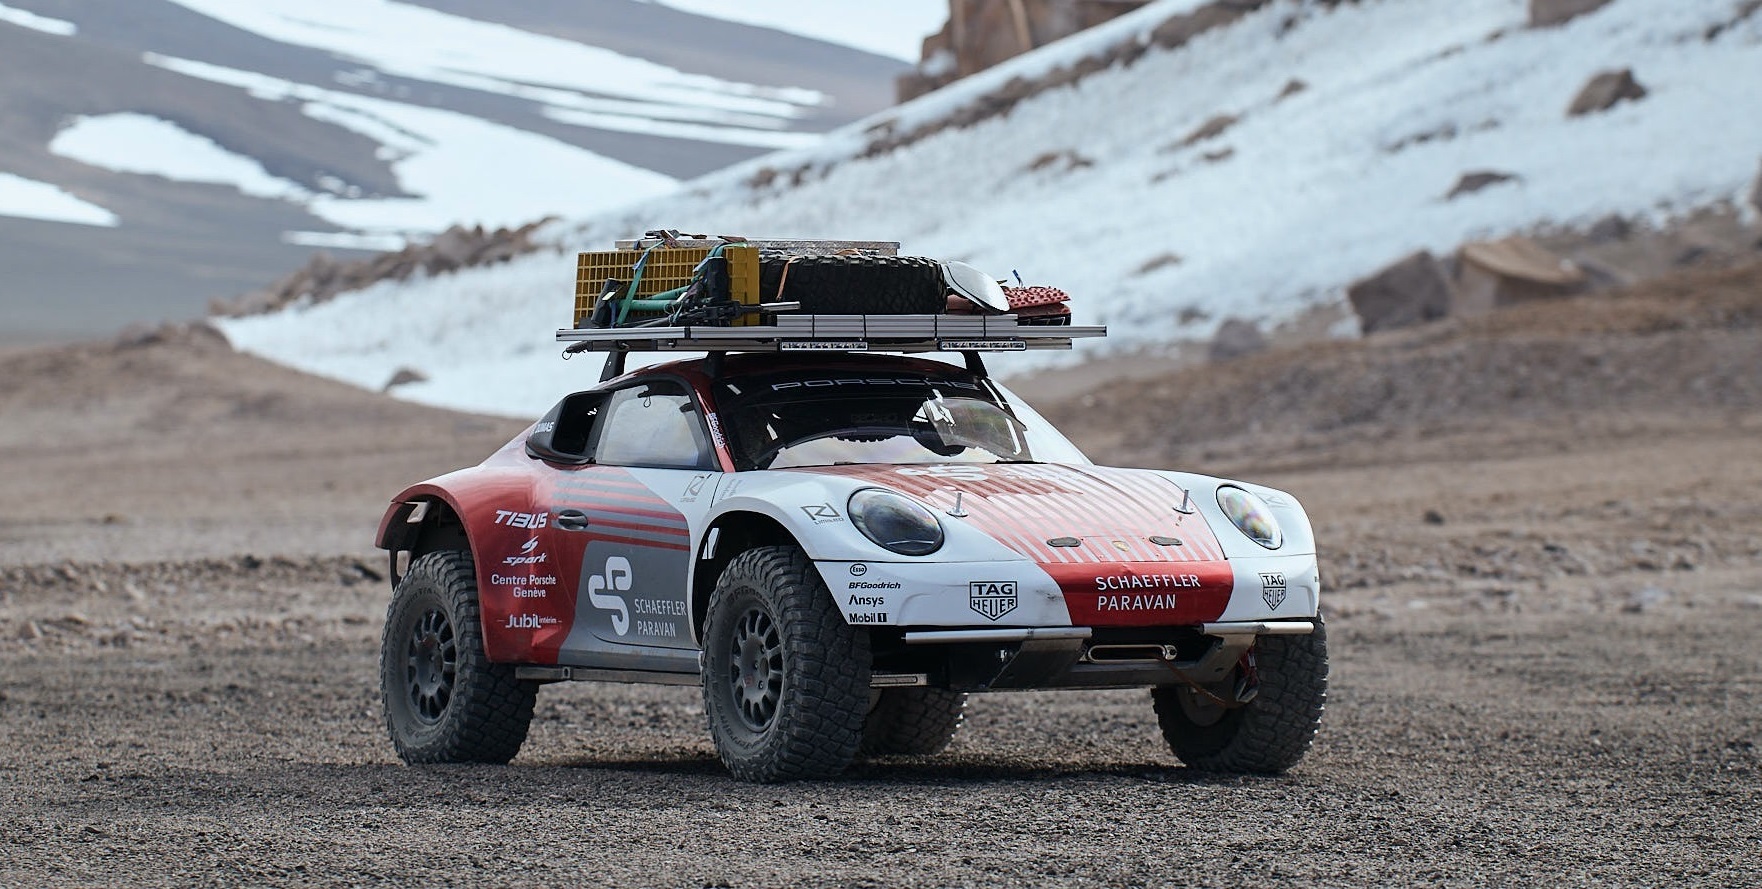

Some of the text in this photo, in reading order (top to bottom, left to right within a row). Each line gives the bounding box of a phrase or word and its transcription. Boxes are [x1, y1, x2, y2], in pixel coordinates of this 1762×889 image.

[771, 378, 980, 391] PORSCHE
[502, 552, 547, 567] spark
[491, 574, 557, 585] Centre Porsche
[848, 581, 901, 589] BFGoodrich
[1095, 574, 1201, 591] SCHAEFFLER
[1262, 574, 1284, 586] TAG
[513, 586, 546, 598] Genève
[973, 583, 1013, 596] TAG
[848, 594, 885, 608] Ansys
[1097, 594, 1176, 611] PARAVAN
[1264, 589, 1285, 607] HEUER
[634, 598, 687, 616] SCHAEFFLER
[972, 598, 1015, 618] HEUER
[505, 613, 541, 629] Jubil
[849, 612, 876, 623] Mobil
[637, 620, 676, 637] PARAVAN
